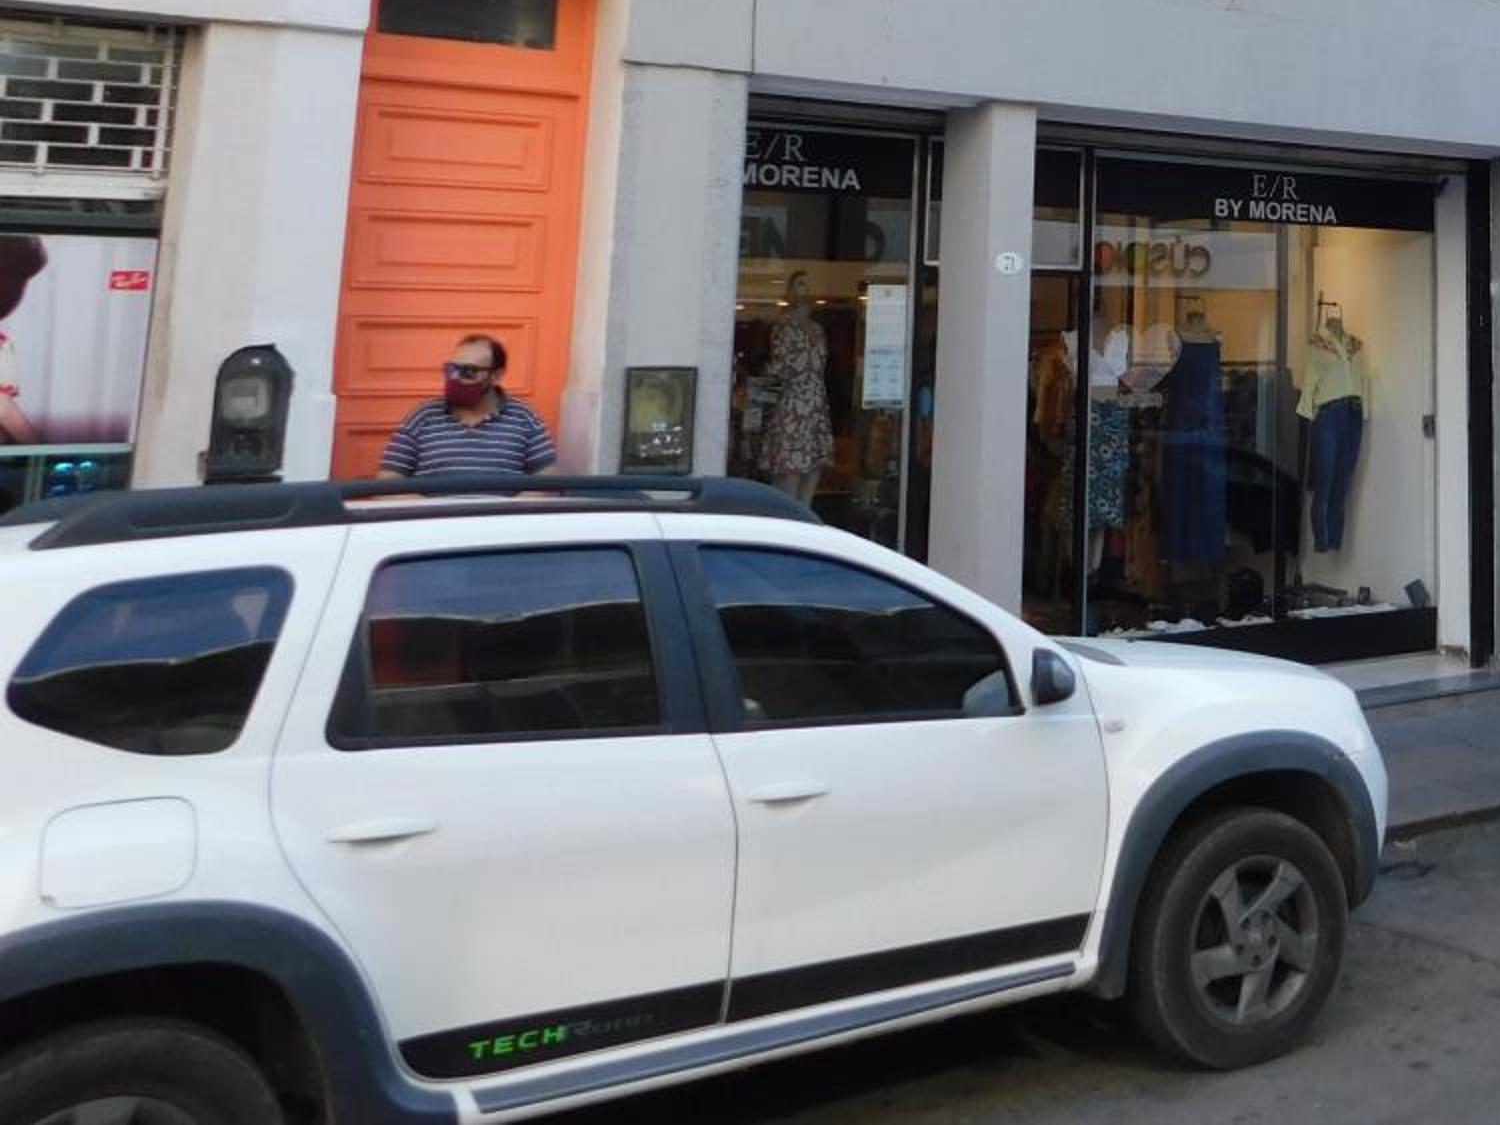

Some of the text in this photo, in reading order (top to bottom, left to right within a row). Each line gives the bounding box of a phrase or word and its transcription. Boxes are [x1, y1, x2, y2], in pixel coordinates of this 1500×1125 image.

[1252, 175, 1298, 200] E/R
[1215, 198, 1337, 224] BY MORENA
[468, 1025, 568, 1059] TECH
